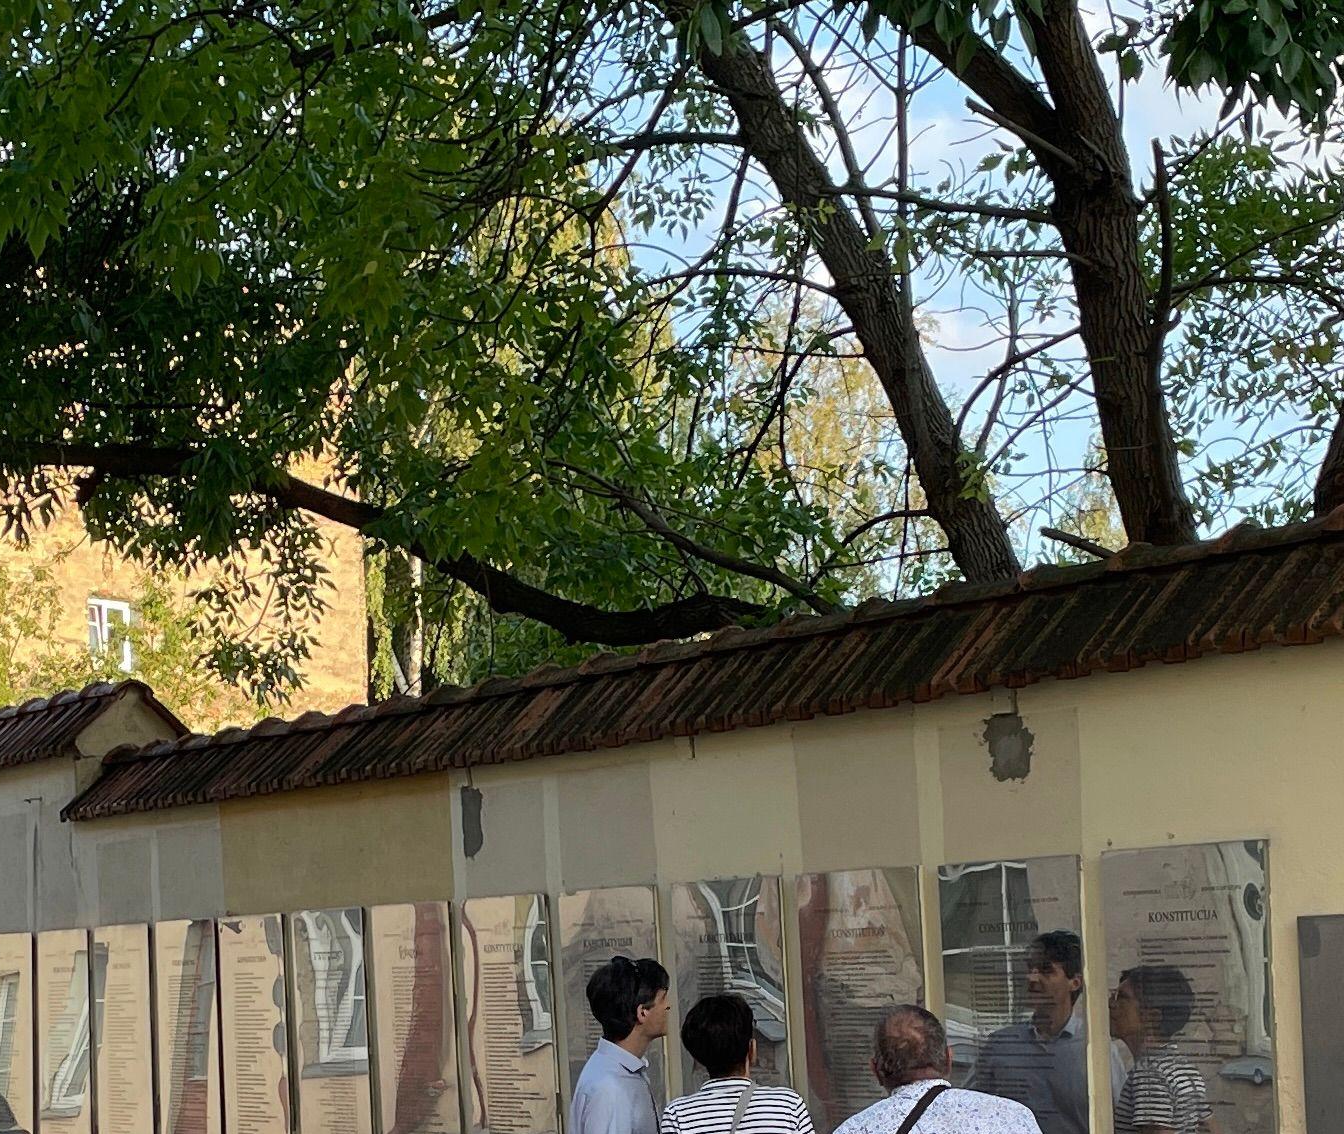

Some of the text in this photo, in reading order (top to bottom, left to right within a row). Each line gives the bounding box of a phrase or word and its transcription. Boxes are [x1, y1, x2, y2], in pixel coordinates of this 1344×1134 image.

[1147, 909, 1219, 923] KONSTITUCIJA
[830, 924, 887, 938] CONSTITUTION
[978, 920, 1040, 934] CONSTITUTION
